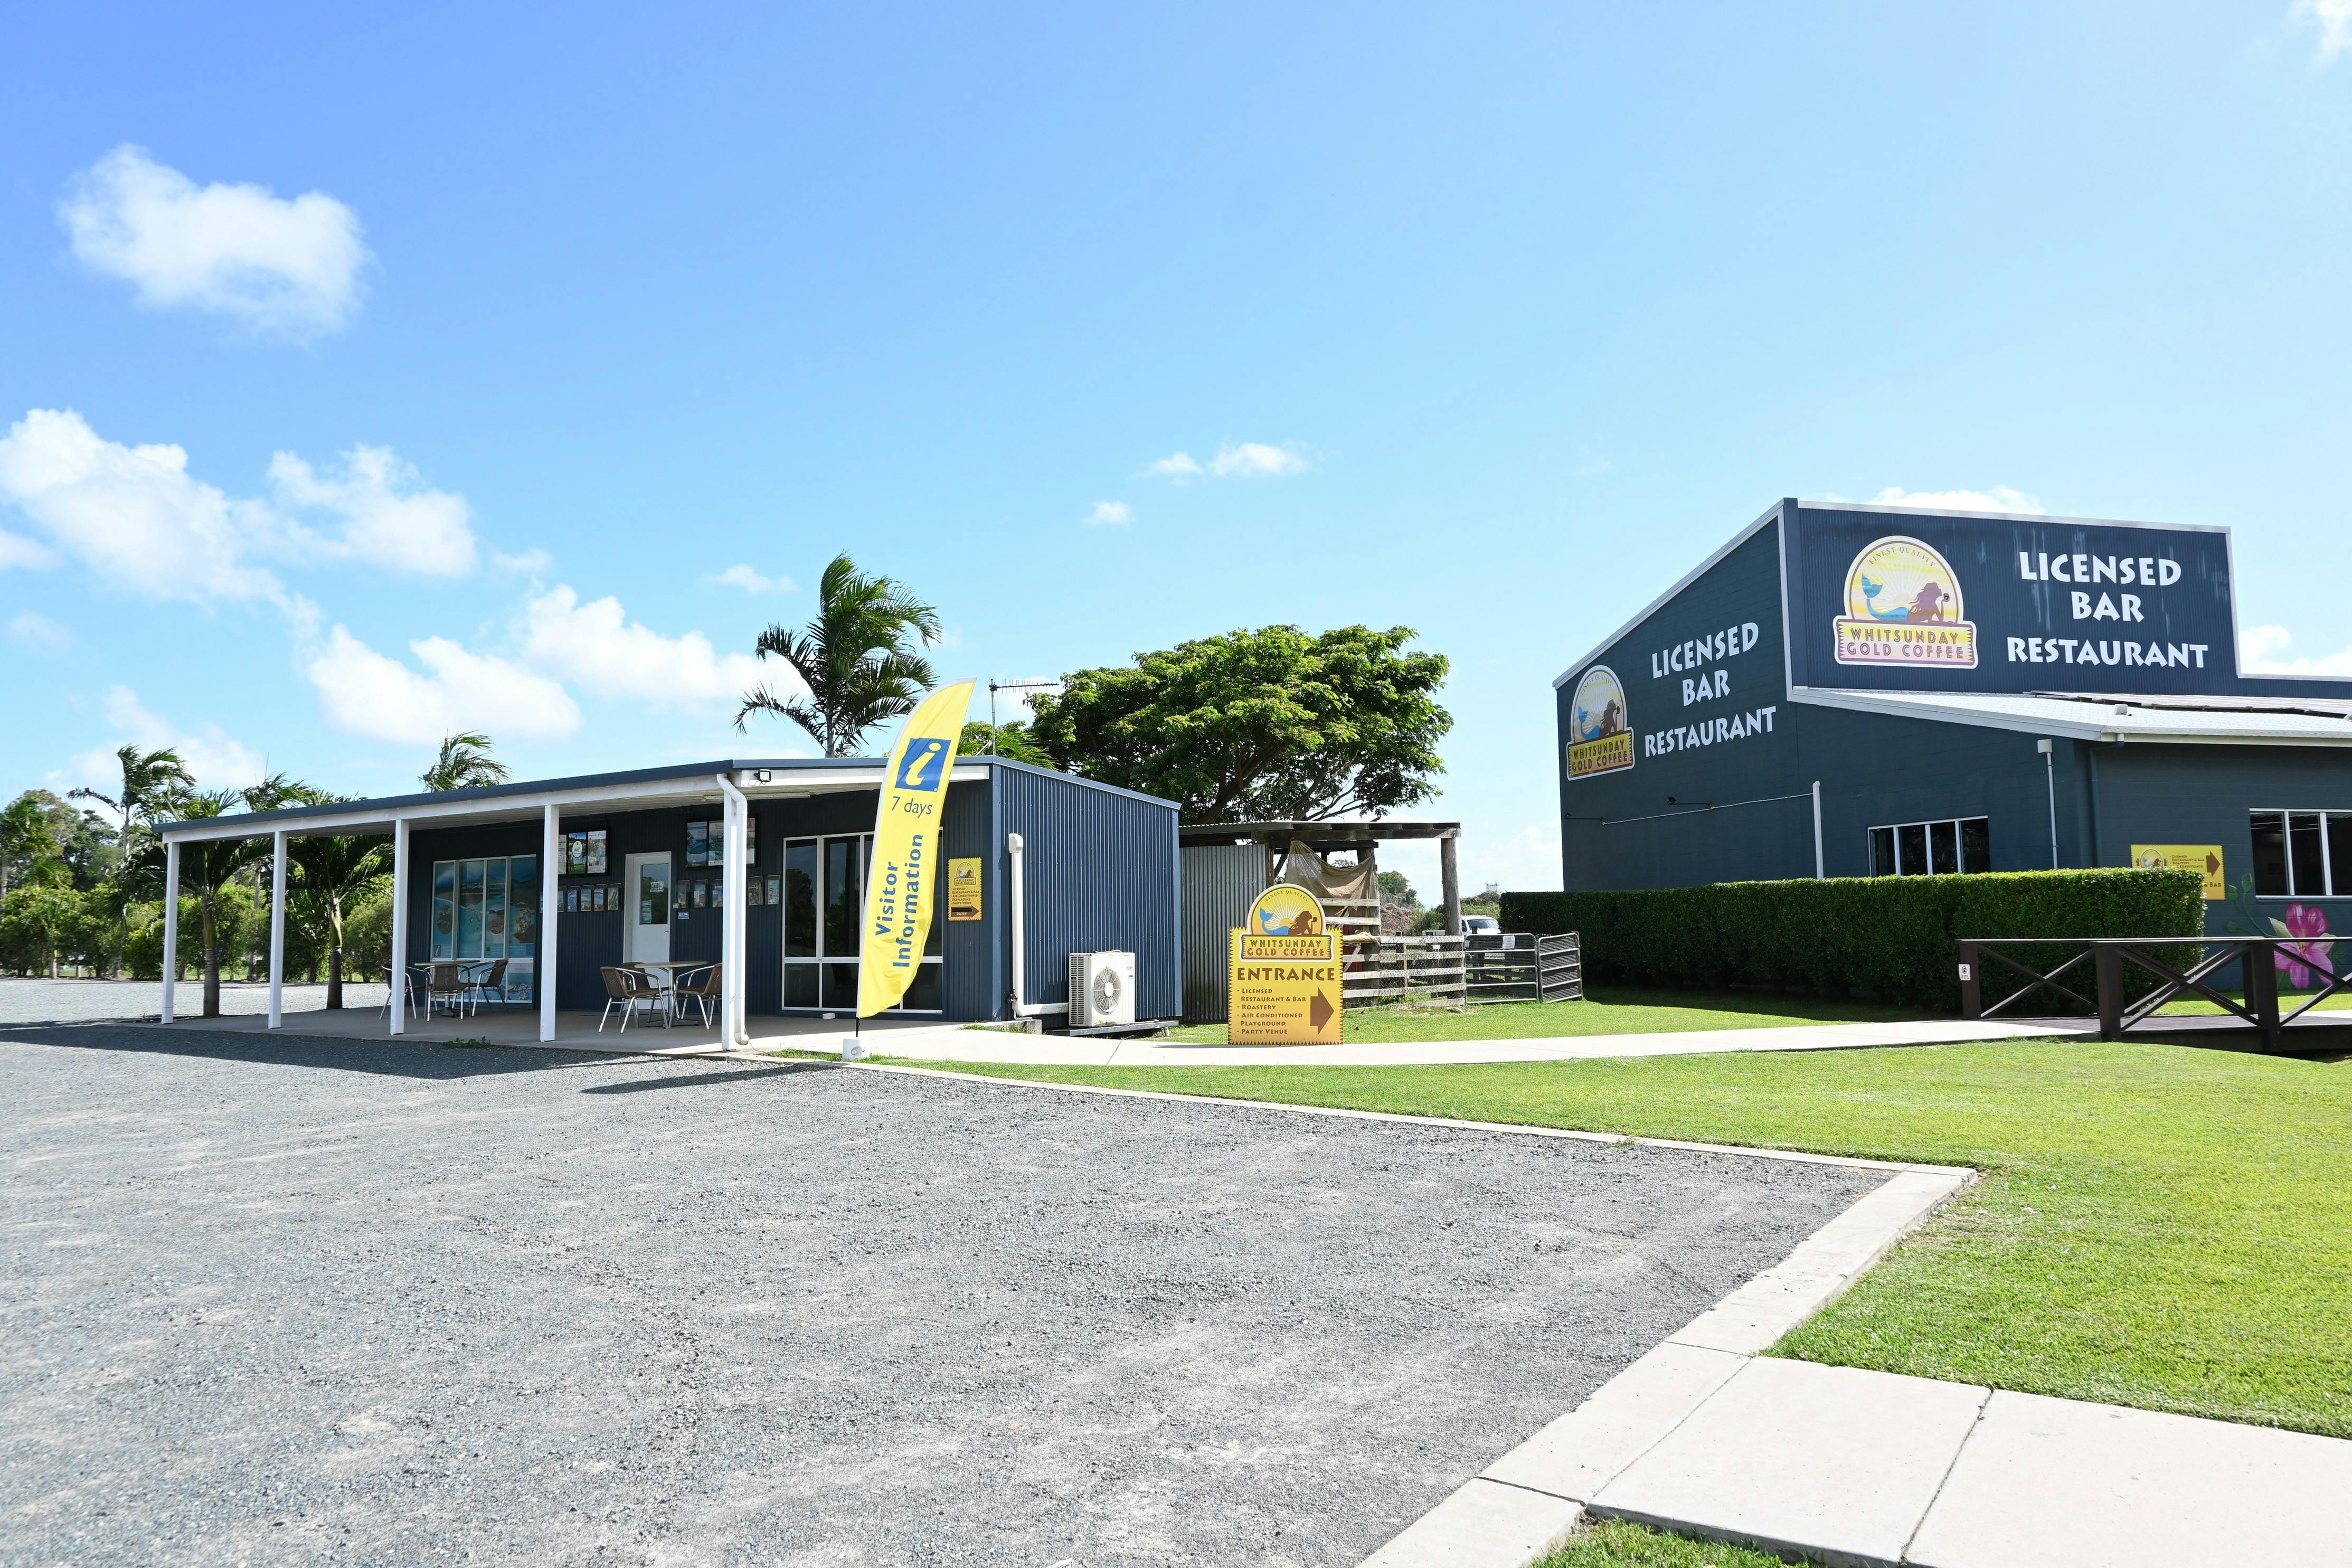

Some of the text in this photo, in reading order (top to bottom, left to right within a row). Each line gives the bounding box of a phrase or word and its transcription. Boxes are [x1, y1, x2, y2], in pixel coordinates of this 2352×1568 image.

[1868, 546, 1935, 566] FINEST QUALITY
[2019, 552, 2181, 586] LICENSED
[2071, 591, 2145, 622] BAR
[1850, 628, 1958, 645] WHITSUNDAY
[1652, 622, 1759, 679] LICENSED
[1847, 642, 1963, 659] GOLD COFFEE
[2007, 637, 2208, 668] RESTAURANT
[1683, 669, 1731, 706] BAR
[1645, 705, 1777, 757] RESTAURANT
[1572, 751, 1627, 772] GOLD COFFEE
[1573, 739, 1624, 760] WHITSUNDAY
[892, 796, 932, 818] 7 days
[875, 861, 898, 936] Visitor
[892, 834, 923, 967] Information
[1265, 891, 1309, 902] FINEST QUALITY
[1238, 967, 1335, 981] ENTRANCE
